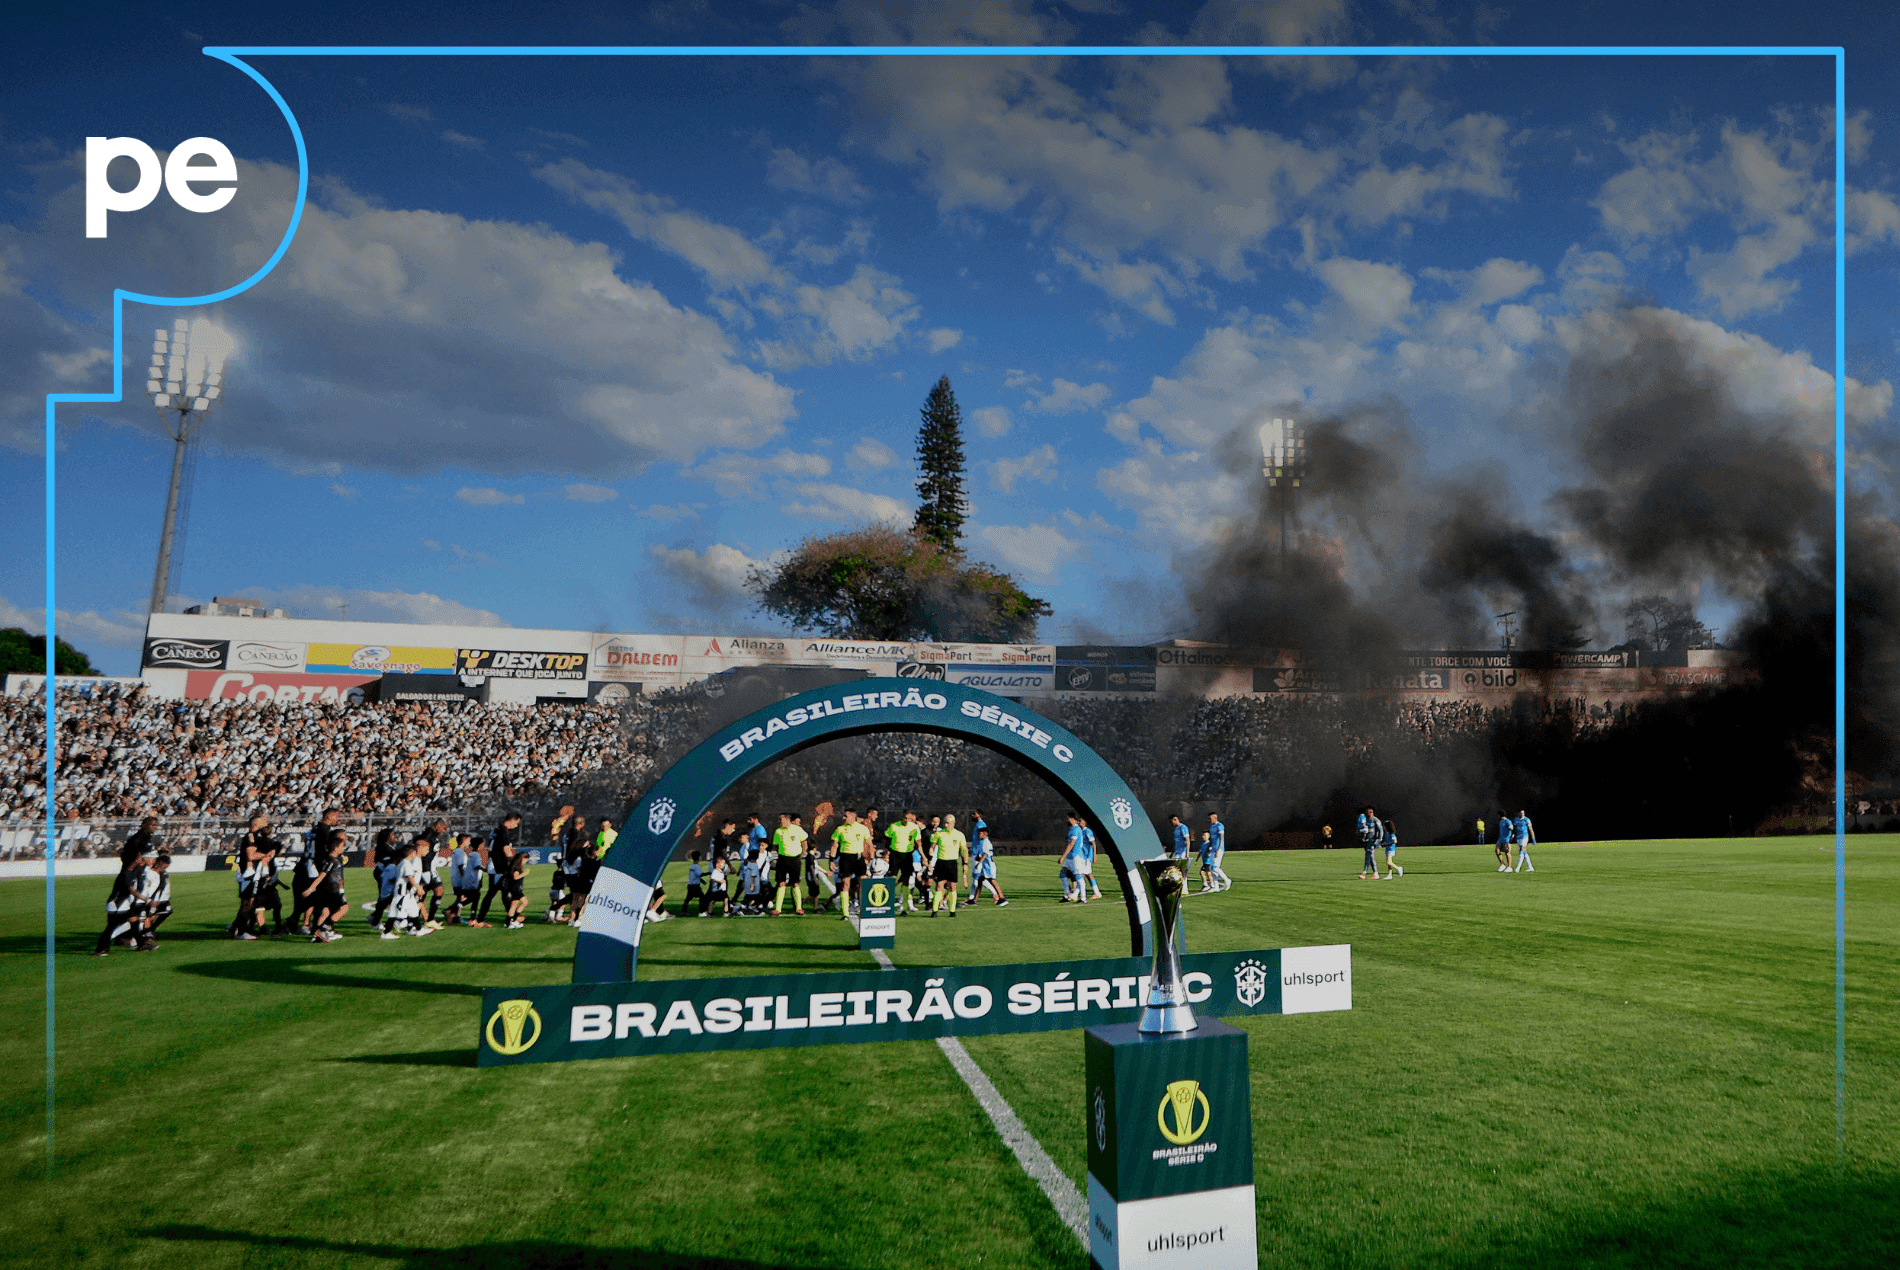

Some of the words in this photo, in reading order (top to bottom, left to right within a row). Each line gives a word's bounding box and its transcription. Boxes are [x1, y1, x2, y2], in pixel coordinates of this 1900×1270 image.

[730, 638, 785, 650] Alianza
[491, 652, 585, 670] DESKTOP
[607, 651, 678, 667] DALBEM
[920, 651, 972, 662] SigmaPort
[1002, 653, 1052, 664] SigmaPort
[1429, 656, 1460, 667] TORCE
[1462, 656, 1485, 667] COM
[1486, 654, 1512, 667] VOCÊ
[350, 660, 422, 674] Savegnago
[458, 667, 467, 676] A
[467, 668, 514, 678] INTERNET
[515, 669, 533, 678] QUE
[534, 670, 555, 679] JOGA
[556, 671, 583, 679] JUNTO
[958, 675, 1043, 688] AGUAJATO
[1482, 670, 1517, 687] bild
[719, 687, 947, 763] BRASILEIRÃO
[960, 698, 1053, 750] SÉRIE
[1052, 744, 1074, 763] C
[587, 892, 642, 920] uhlsport
[1283, 970, 1346, 987] uhlsport
[569, 977, 993, 1043] BRASILEIRÃO
[1182, 971, 1213, 1003] C
[1152, 1141, 1218, 1160] BRASILEIRÃO
[1147, 1226, 1225, 1252] uhlsport
